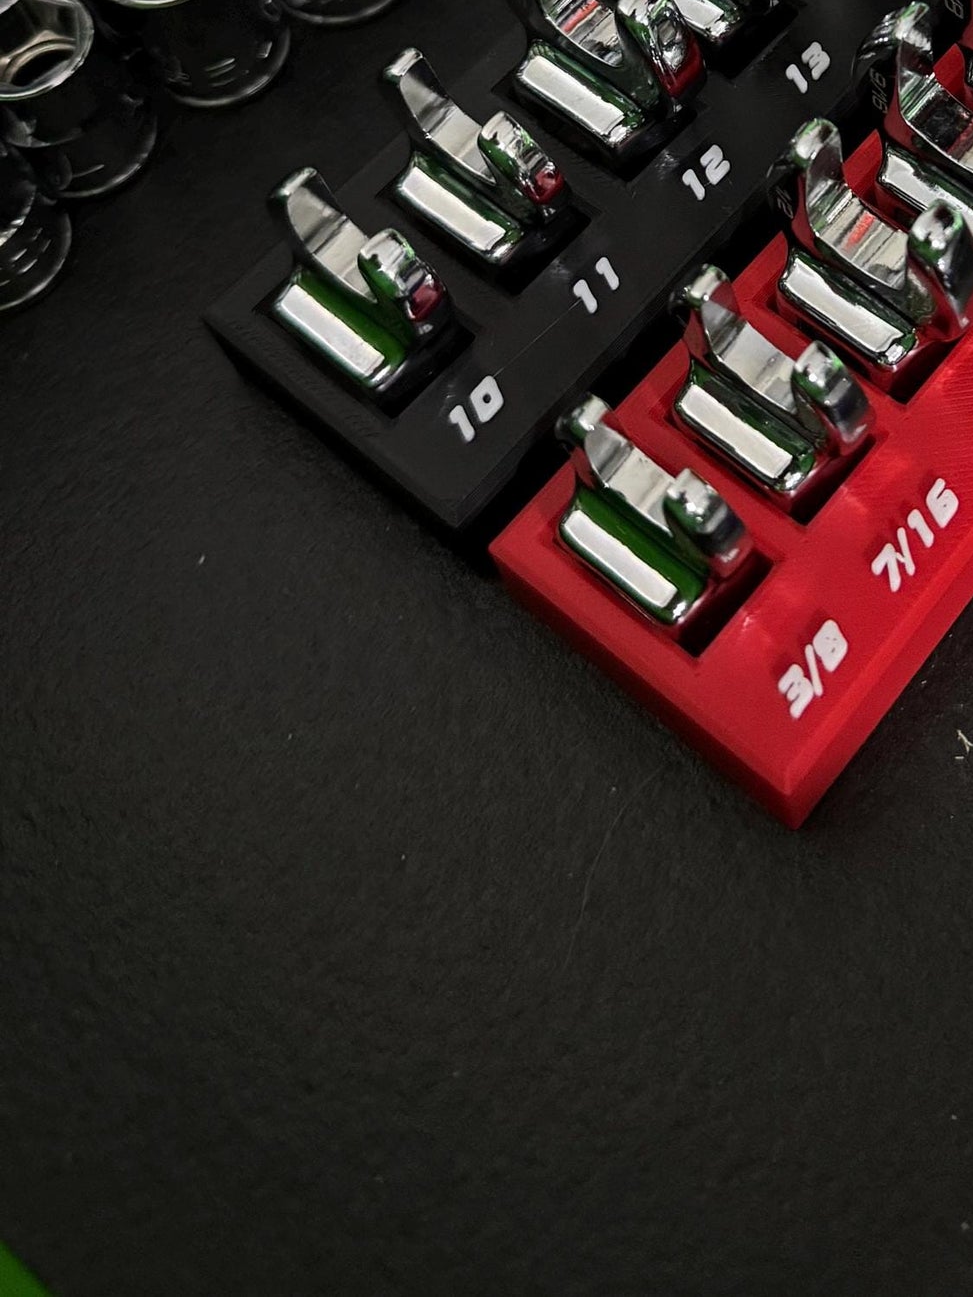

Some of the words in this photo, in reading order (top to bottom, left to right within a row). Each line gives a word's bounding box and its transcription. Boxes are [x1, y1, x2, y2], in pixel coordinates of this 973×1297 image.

[785, 41, 831, 94] 13
[682, 144, 731, 201] 12
[573, 256, 620, 314] 11
[449, 375, 504, 442] 10
[871, 478, 959, 592] 7/16
[778, 619, 848, 719] 3/8
